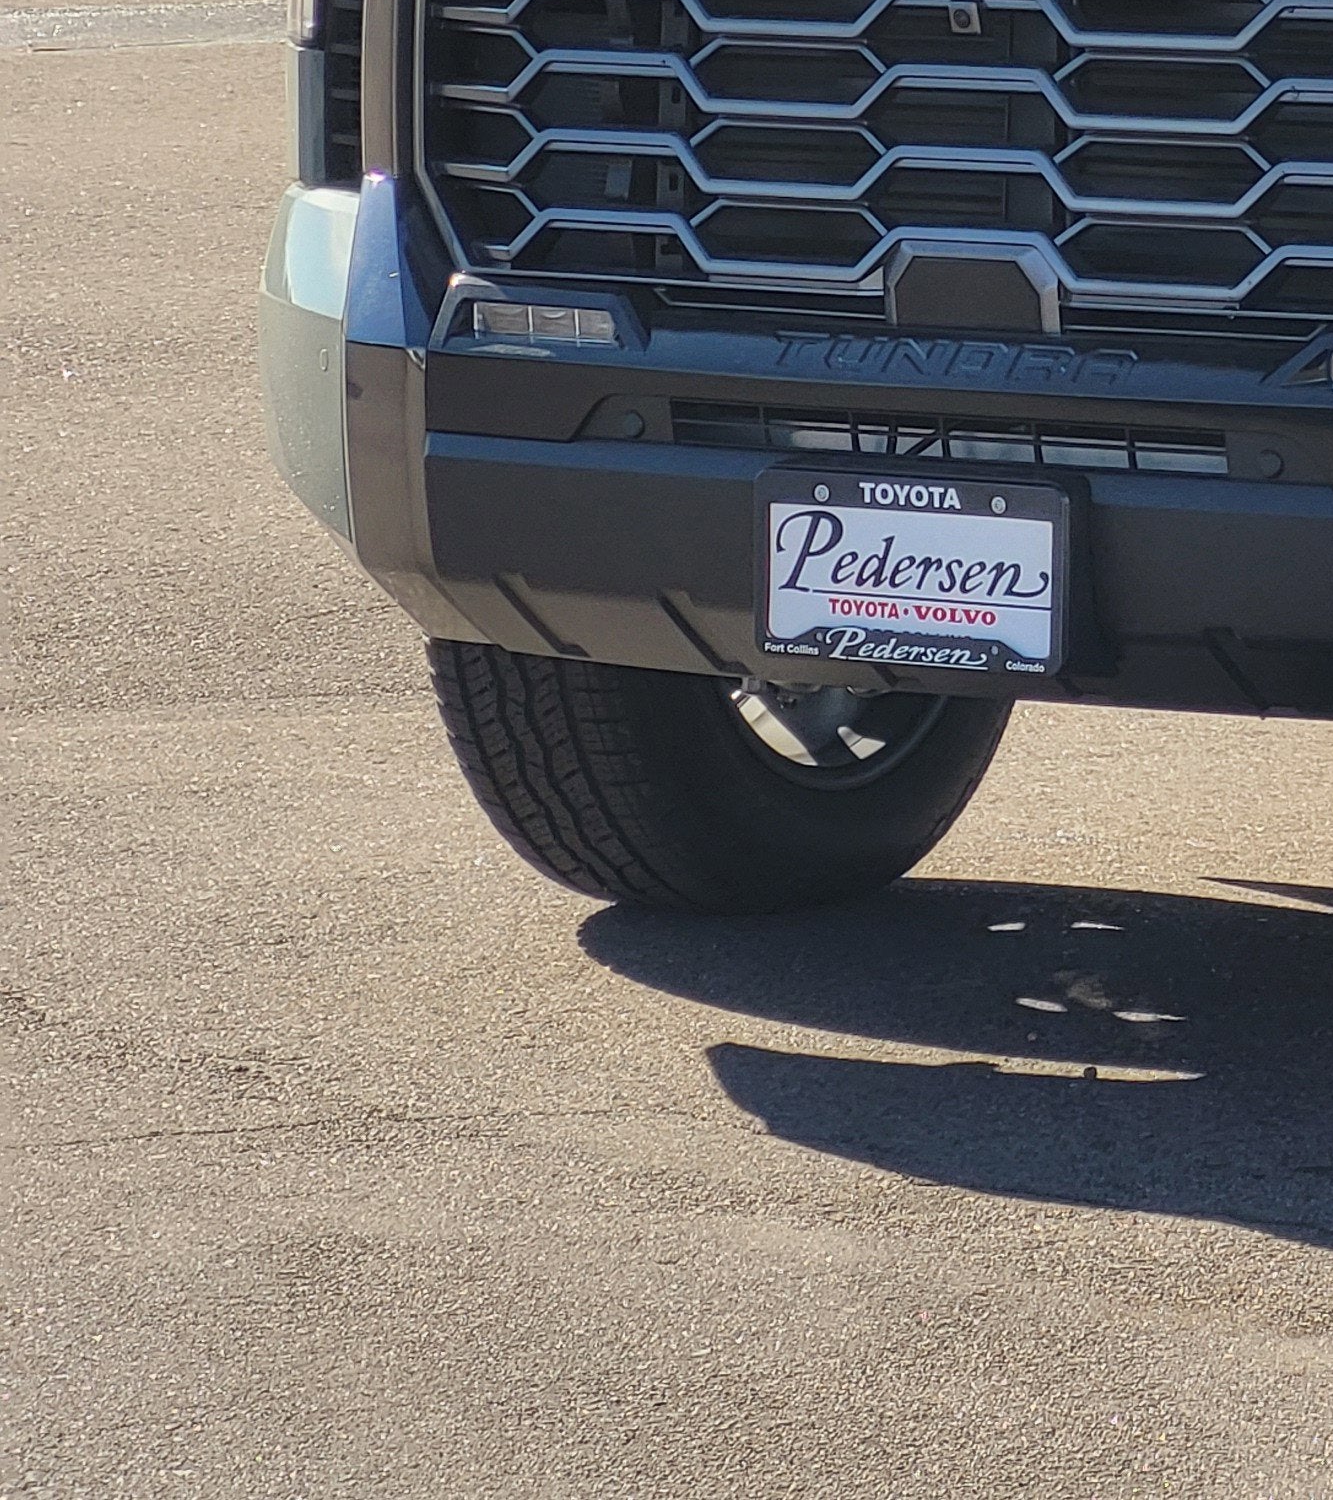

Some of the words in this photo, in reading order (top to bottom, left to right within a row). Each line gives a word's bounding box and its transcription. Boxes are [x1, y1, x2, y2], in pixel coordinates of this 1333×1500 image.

[774, 330, 1138, 384] TUNDRA
[859, 482, 961, 510] TOYOTA
[776, 510, 1050, 598] Pedersen
[828, 598, 899, 619] TOYOTA
[912, 605, 996, 626] VOLVO
[764, 642, 785, 653] Fort
[787, 643, 819, 655] Collins
[826, 628, 988, 668] Pedersen
[1005, 660, 1045, 673] Colorado
